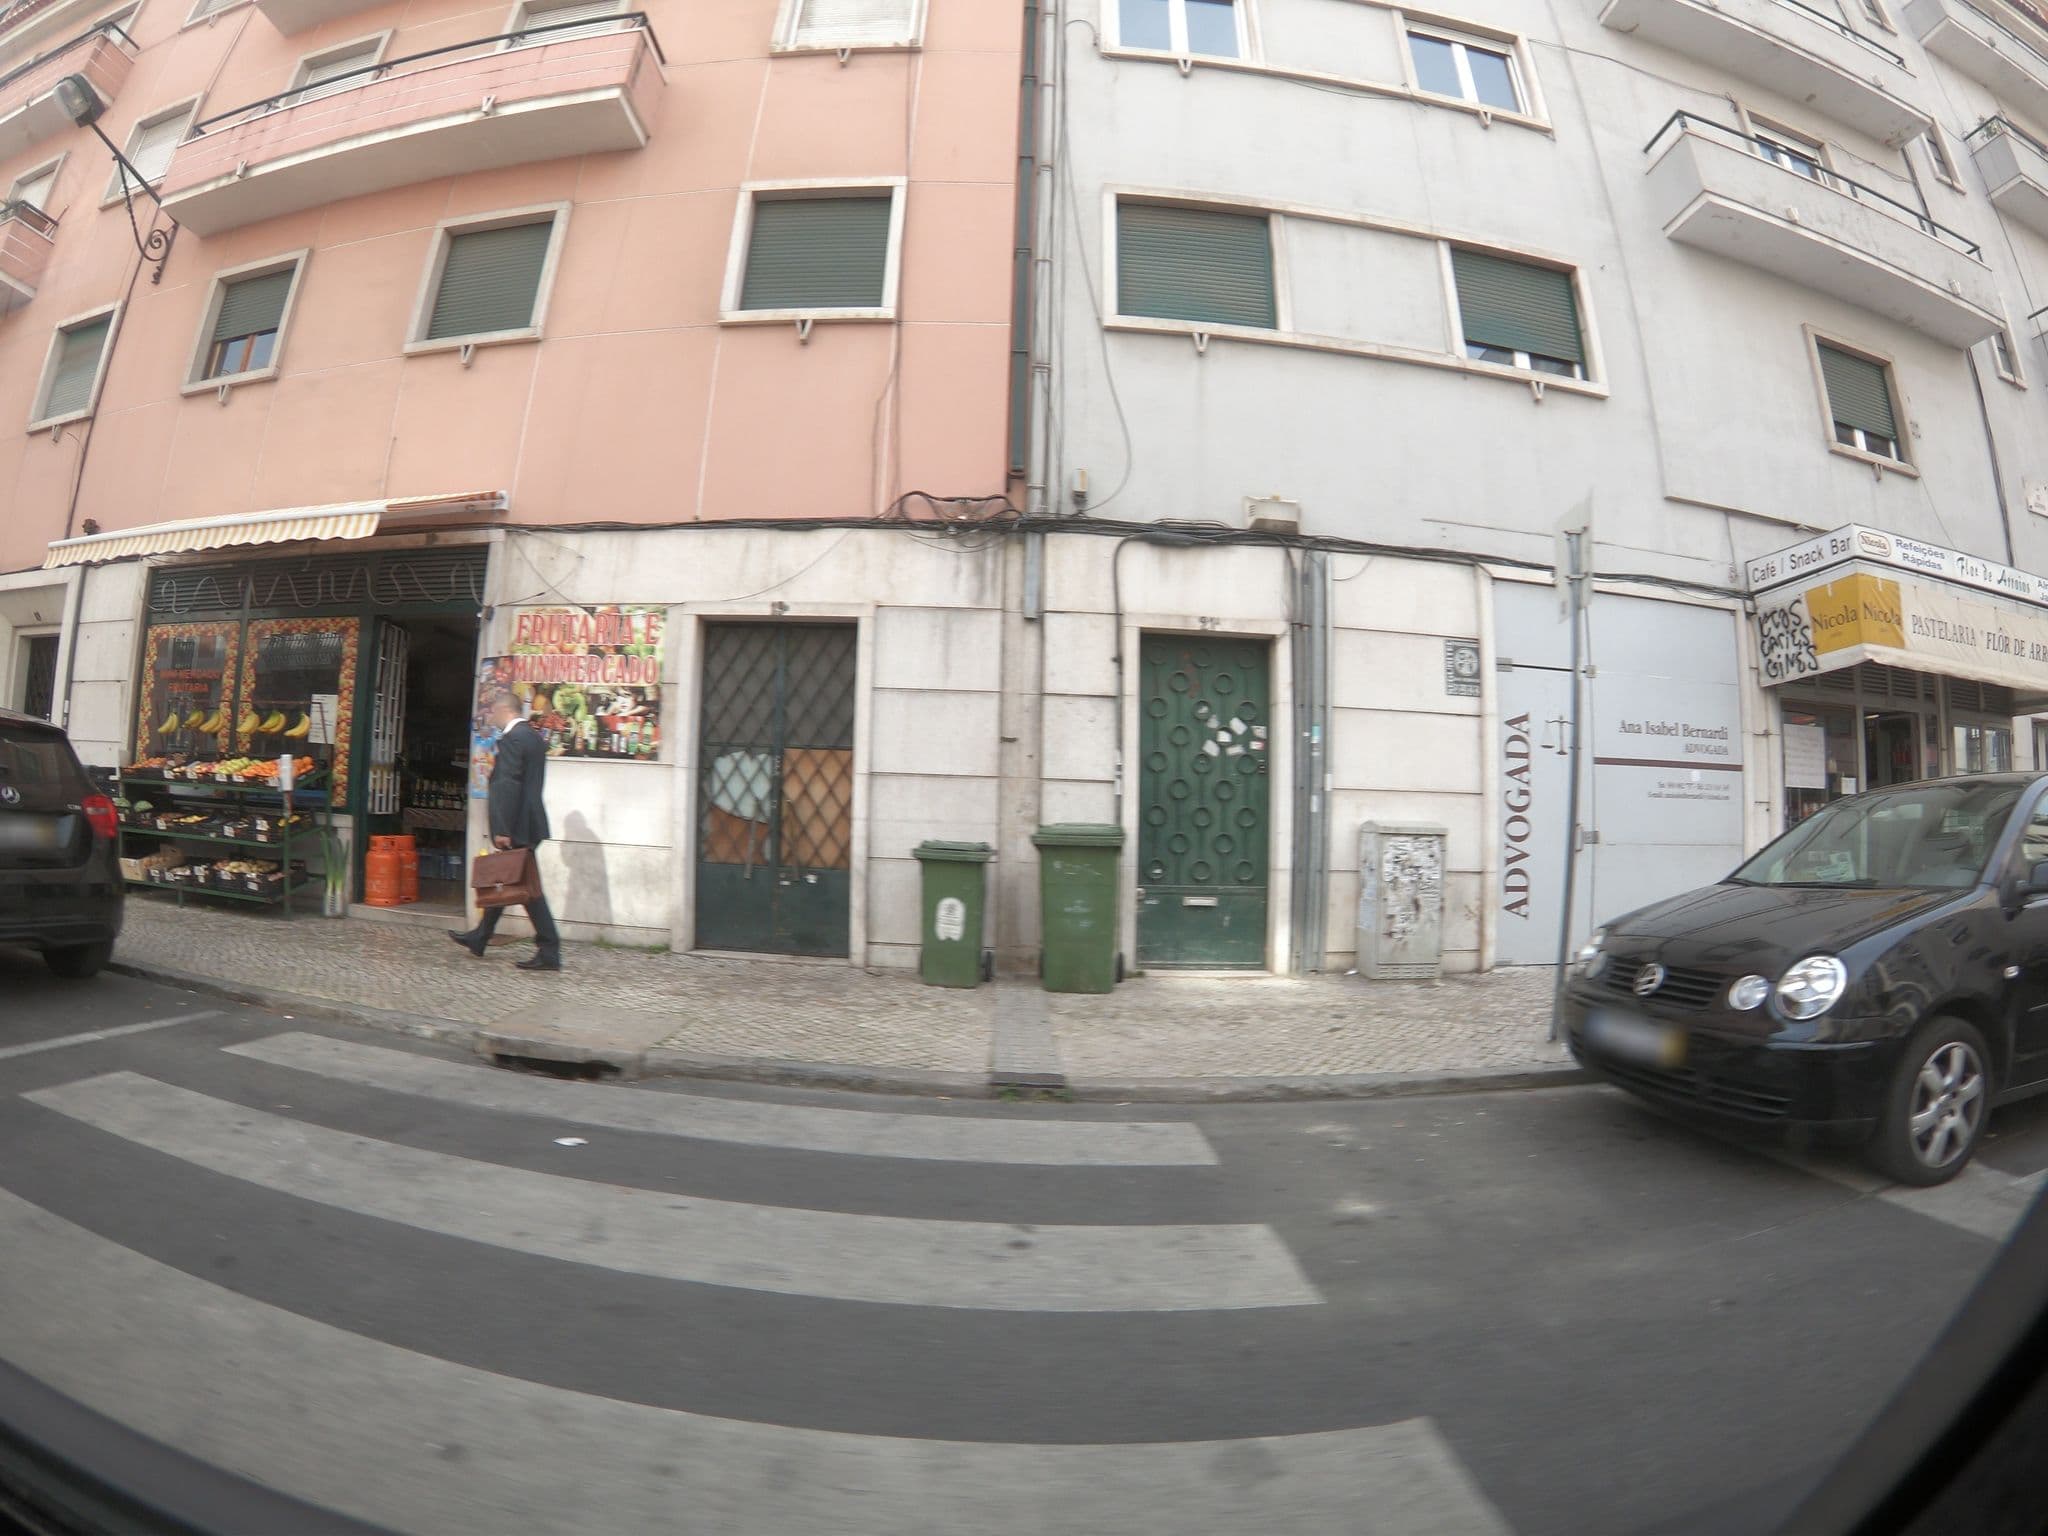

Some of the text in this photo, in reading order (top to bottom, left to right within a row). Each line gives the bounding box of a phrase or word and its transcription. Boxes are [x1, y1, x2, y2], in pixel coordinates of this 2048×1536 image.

[1752, 560, 1777, 583] Café
[1789, 544, 1825, 570] Snack
[1830, 536, 1851, 556] Bar
[1895, 538, 1945, 560] Refeições
[1902, 552, 1943, 571] Rápidas
[1956, 556, 1979, 577] Flor
[1997, 569, 2030, 594] Arroios
[516, 612, 661, 645] FRUTARIA E
[1811, 604, 1858, 633] Nicola
[1863, 601, 1902, 628] Nicola
[1911, 614, 1977, 647] PASTELARIA
[2013, 638, 2026, 658] DE
[511, 654, 660, 685] MINIMERCADO
[1618, 720, 1729, 740] Ana Isabel Bernardi
[1684, 743, 1729, 756] ADVOGADA
[1503, 712, 1531, 920] ADVOGADA
